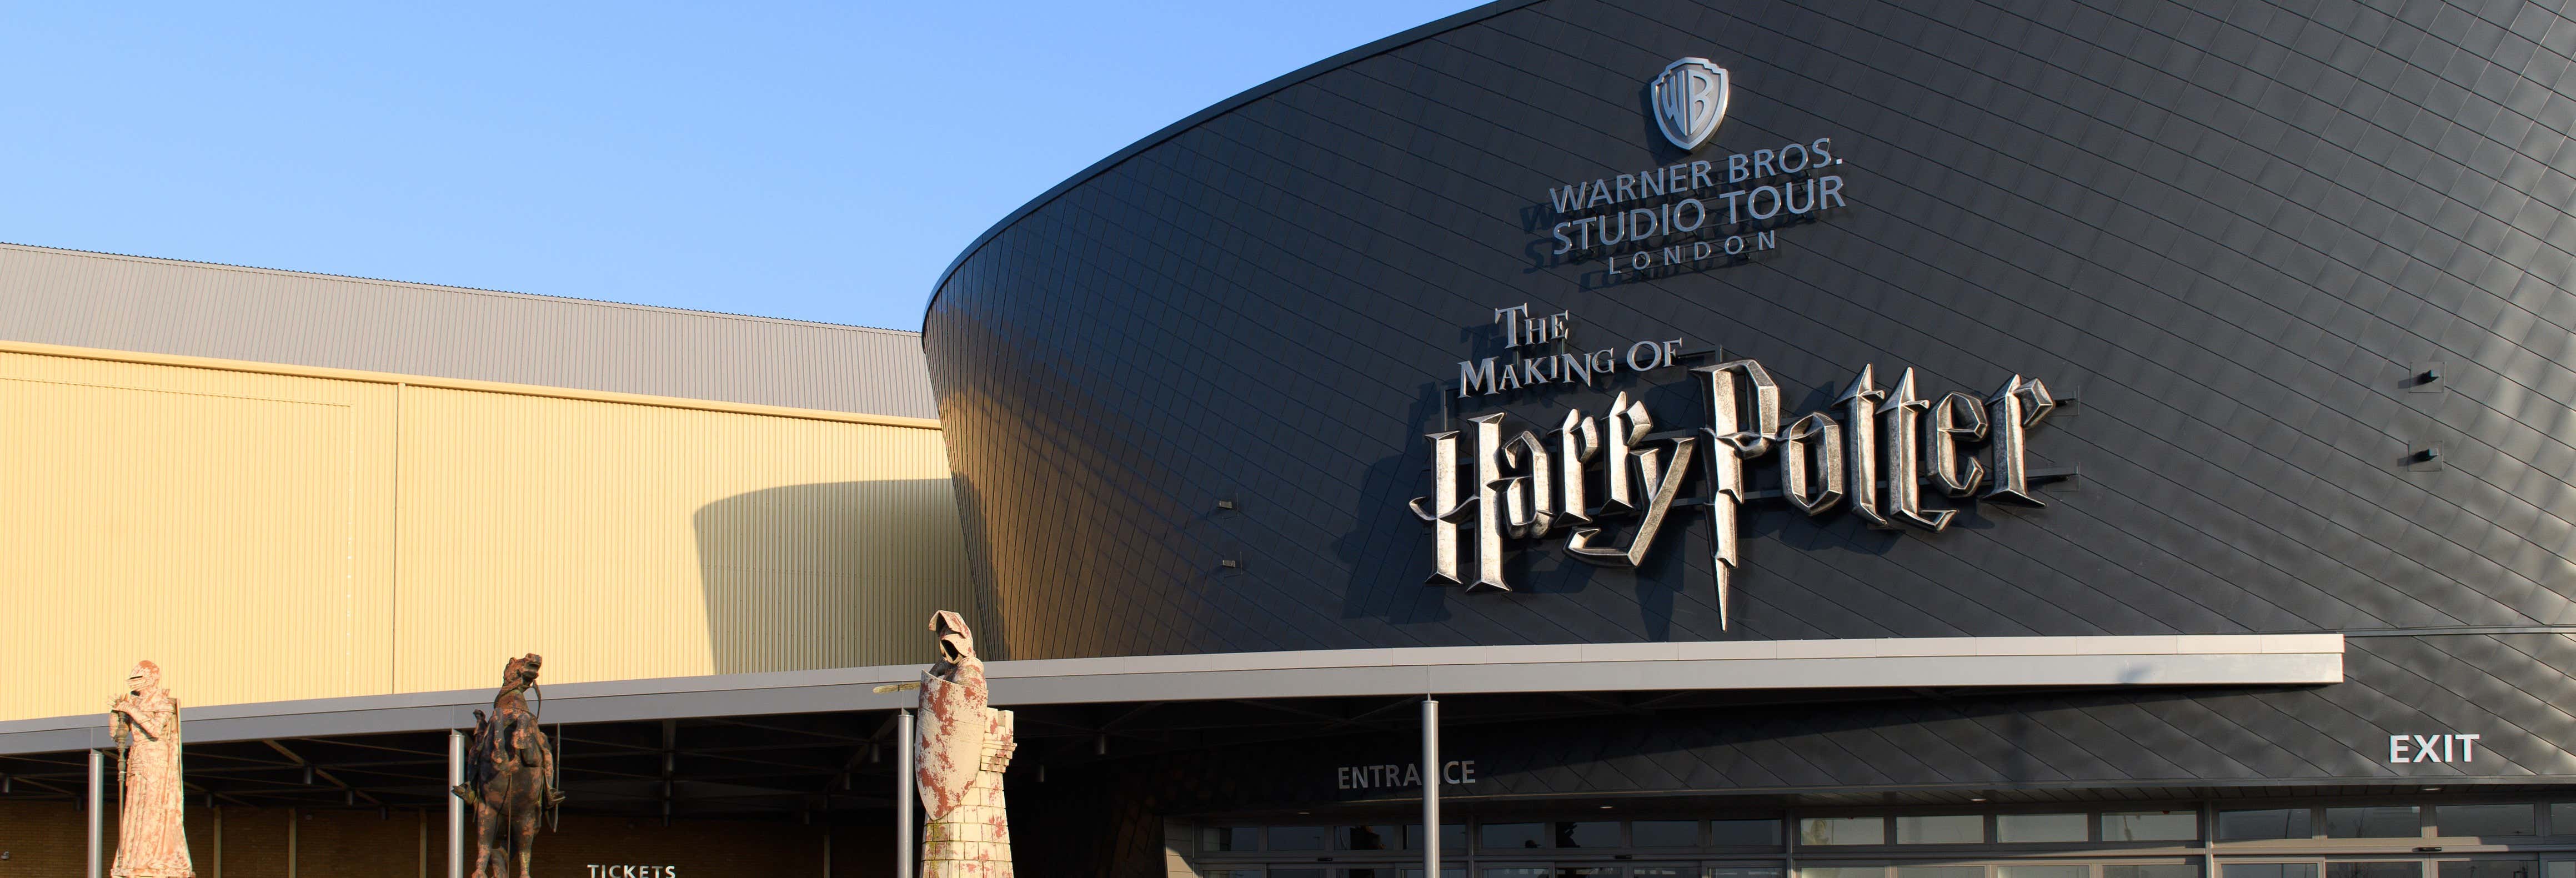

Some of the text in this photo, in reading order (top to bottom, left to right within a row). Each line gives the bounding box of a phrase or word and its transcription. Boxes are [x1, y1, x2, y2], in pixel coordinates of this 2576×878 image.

[1662, 69, 1713, 136] WB
[1550, 138, 1843, 213] WARNER BROS.
[1553, 175, 1846, 255] STUDIO TOUR
[1609, 230, 1775, 274] LONDON
[1627, 338, 1683, 372] OF
[1409, 358, 2056, 633] Harry Potter
[2390, 734, 2480, 763] EXIT
[1338, 760, 1476, 790] ENTRACE
[587, 864, 676, 878] TICKETS
